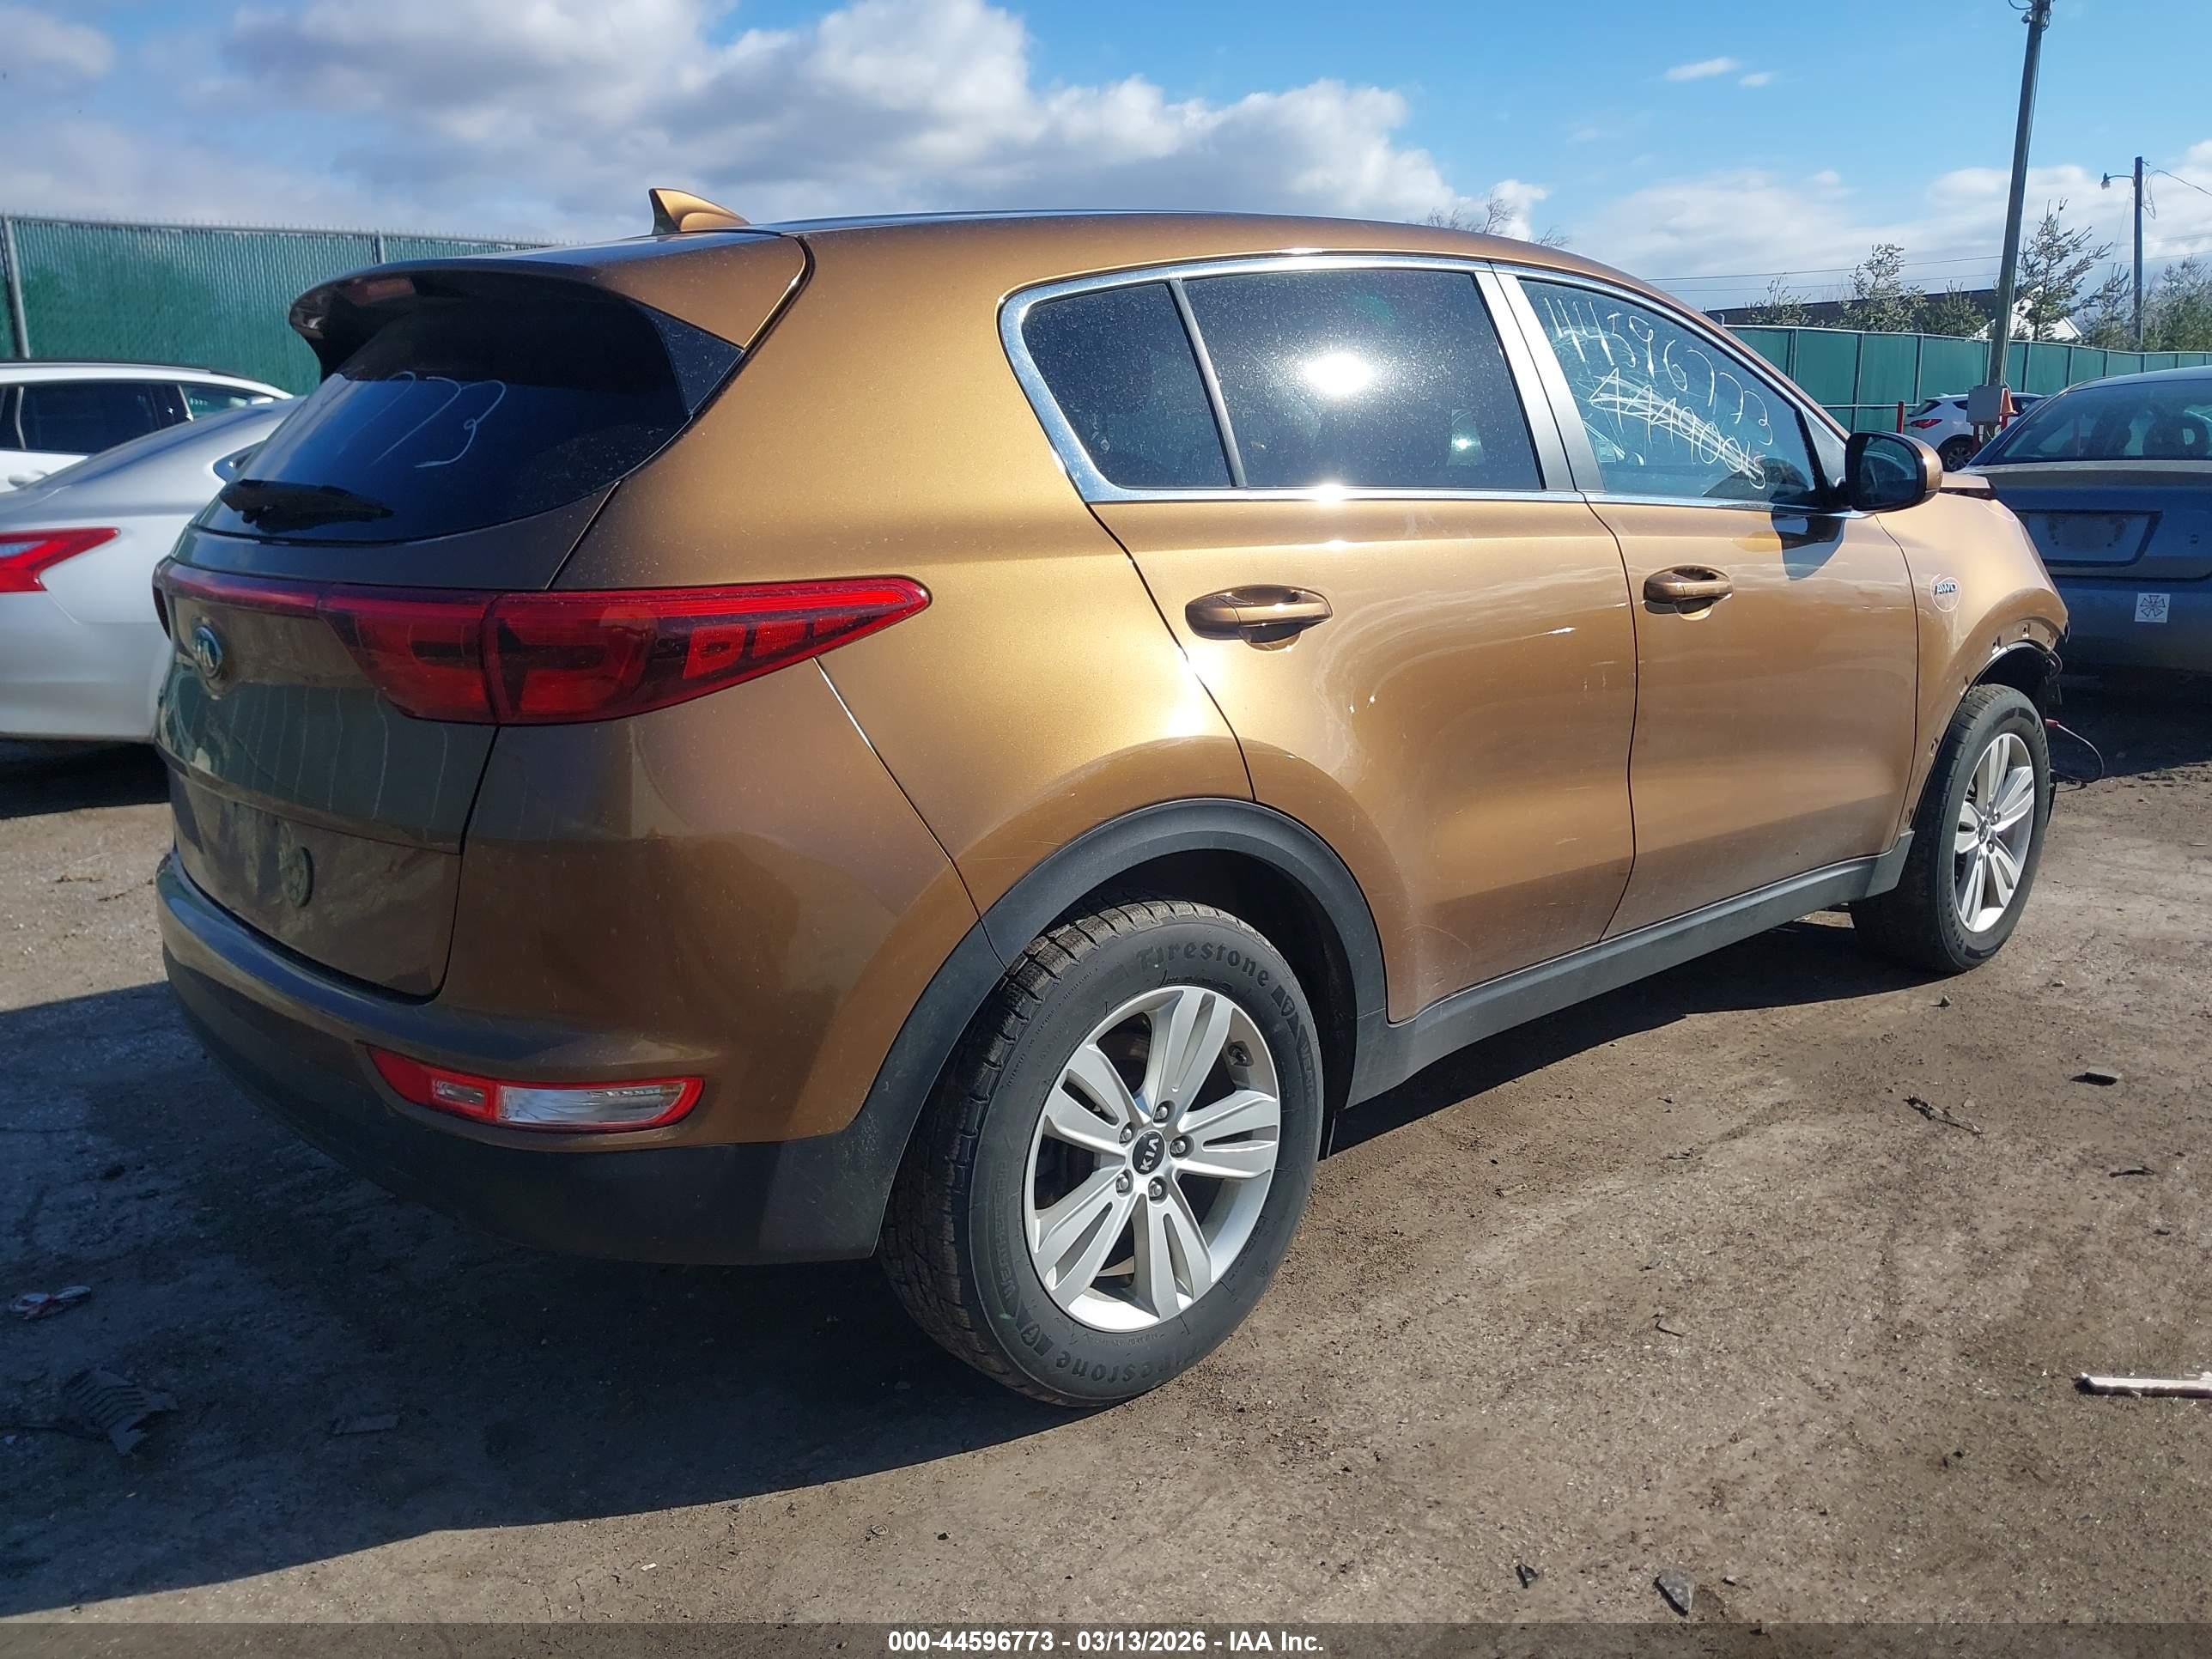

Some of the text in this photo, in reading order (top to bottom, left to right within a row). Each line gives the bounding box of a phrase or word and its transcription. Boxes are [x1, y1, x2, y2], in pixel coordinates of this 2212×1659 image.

[1544, 297, 1773, 446] 44596773
[1935, 582, 1957, 595] AWD
[1135, 941, 1271, 987] Firestone
[1139, 1138, 1159, 1171] KIA
